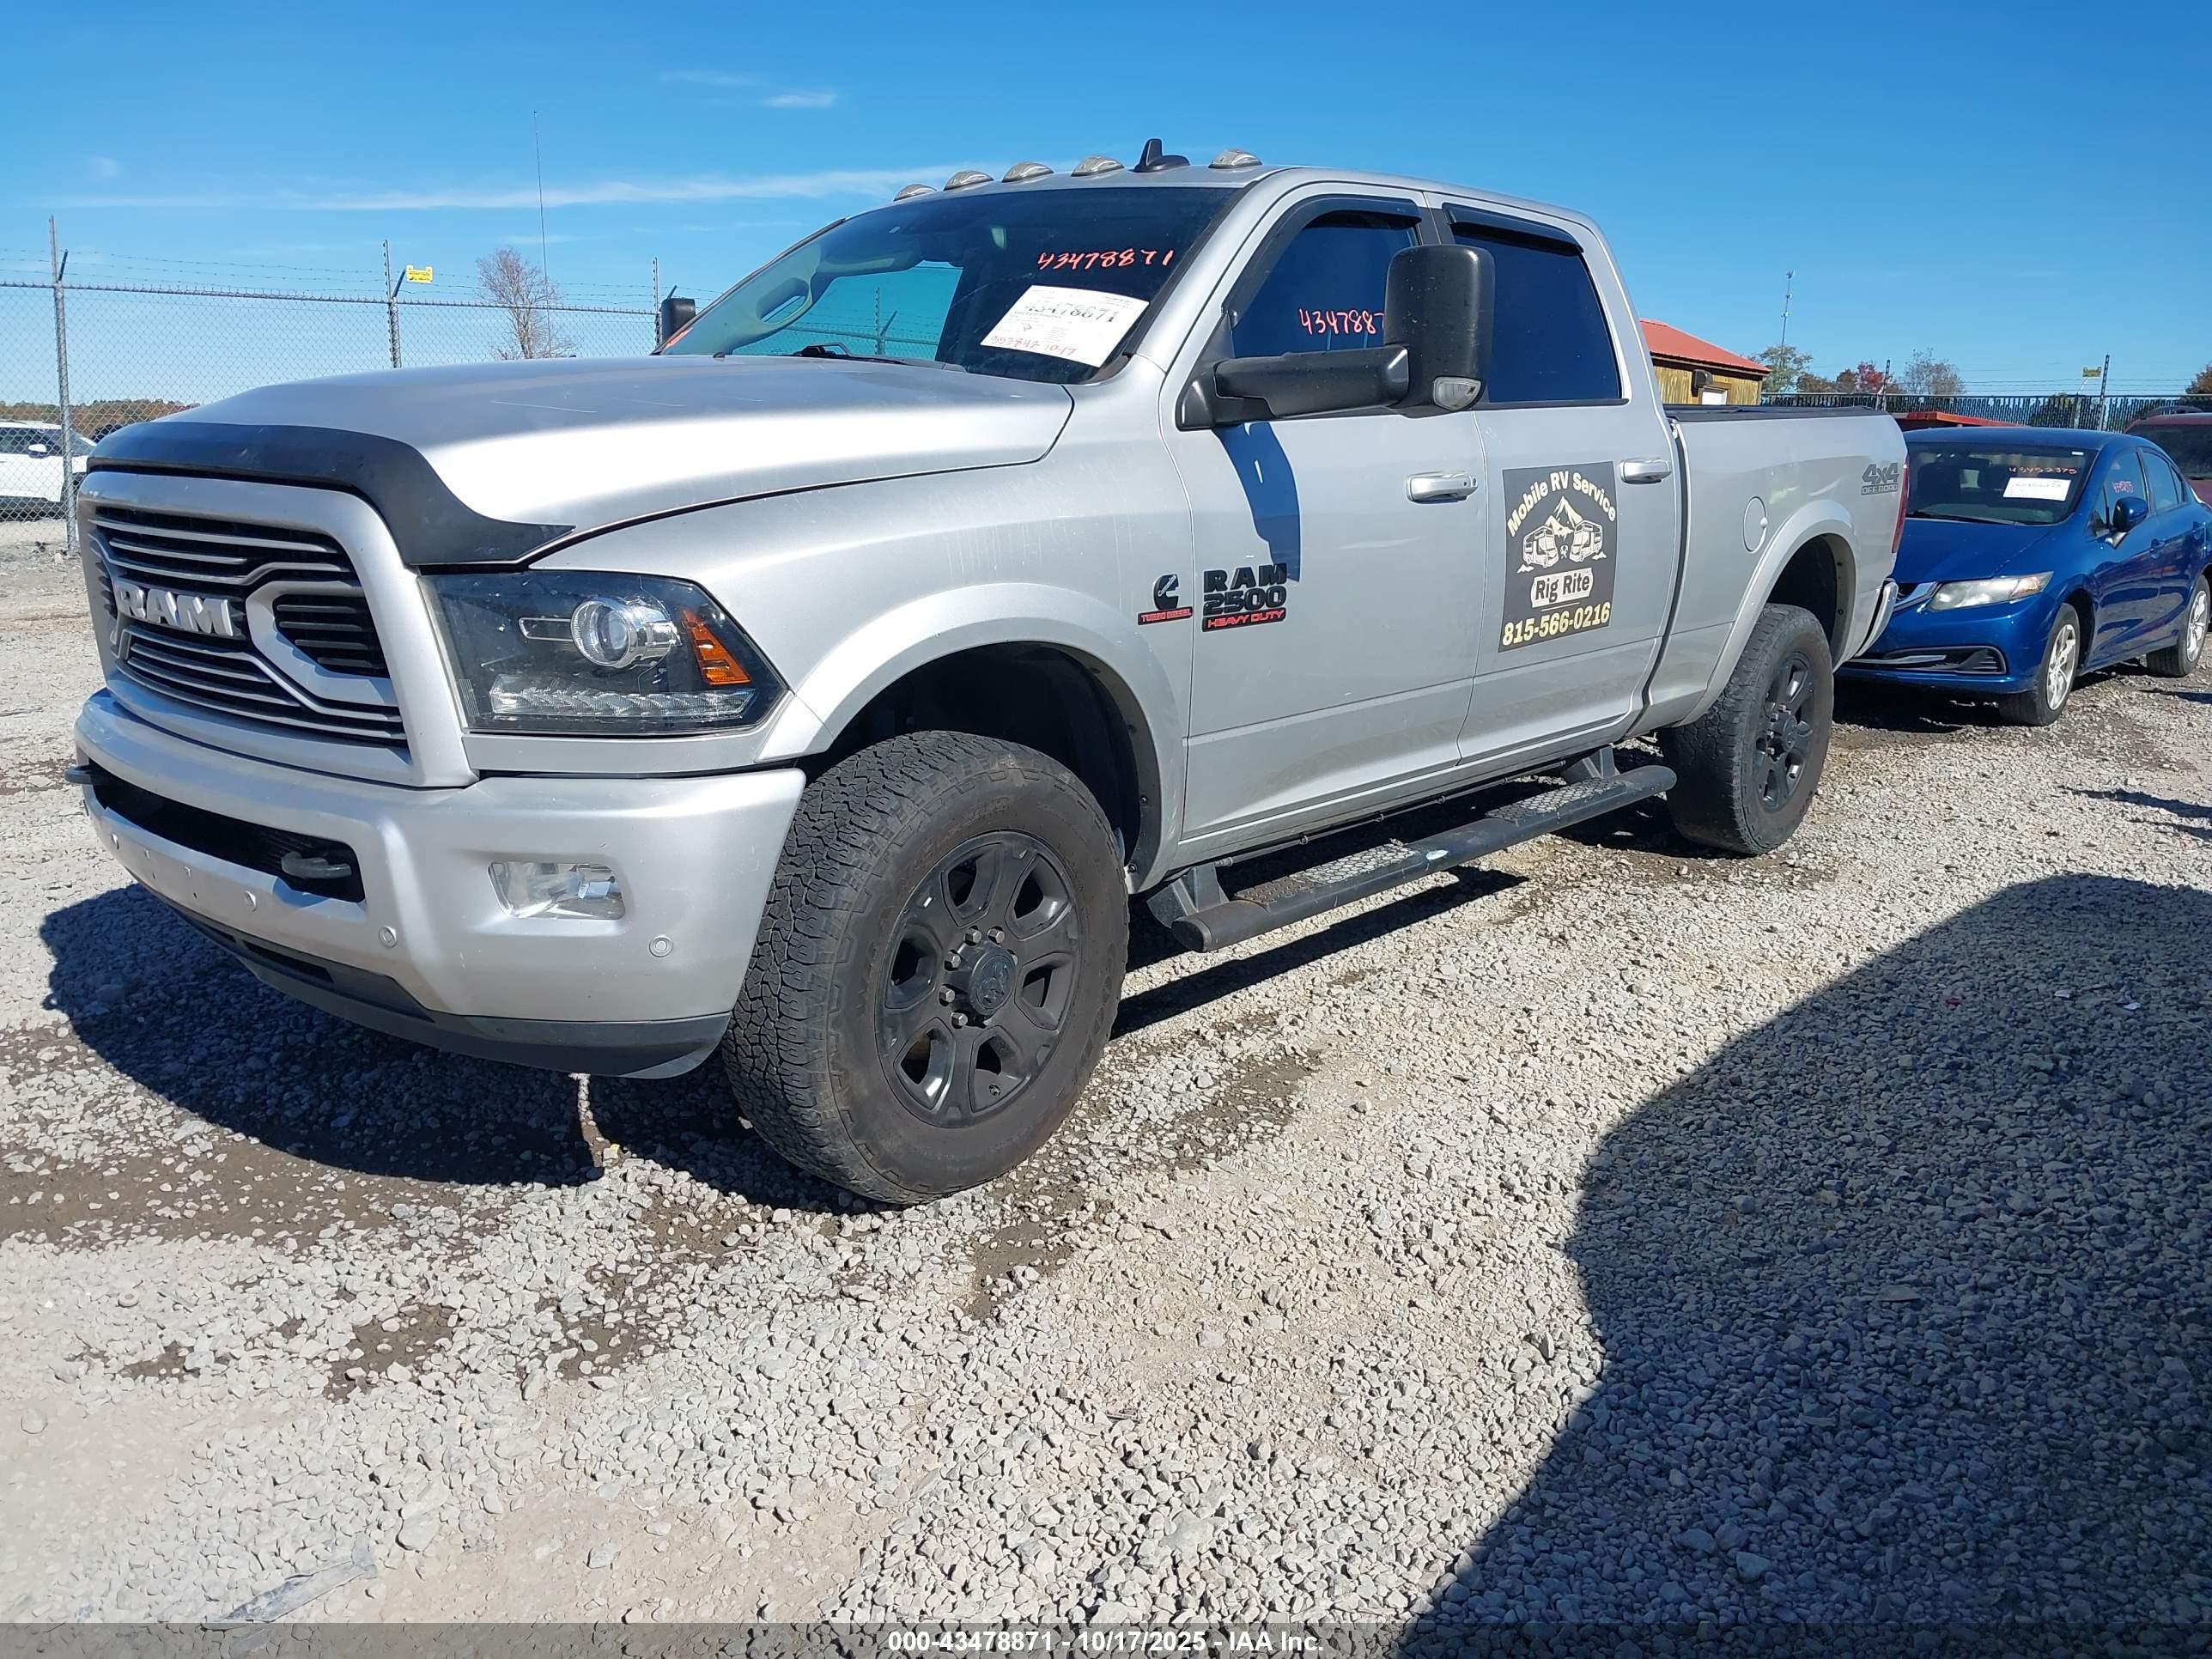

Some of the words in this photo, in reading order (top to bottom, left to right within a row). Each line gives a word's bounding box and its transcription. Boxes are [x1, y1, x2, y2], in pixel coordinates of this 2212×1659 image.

[1038, 248, 1174, 270] 43478871
[1862, 462, 1899, 484] 4x4
[1507, 481, 1548, 537] Mobile
[1550, 471, 1569, 492] RV
[1572, 472, 1616, 523] Service
[1204, 563, 1287, 592] RAM
[1535, 578, 1559, 604] Rig
[1563, 572, 1590, 594] Rite
[117, 580, 233, 636] RAM
[1203, 586, 1286, 616] 2500
[1207, 615, 1250, 628] HEAVY
[1251, 610, 1285, 623] DUTY
[1502, 602, 1610, 646] 815-566-0216
